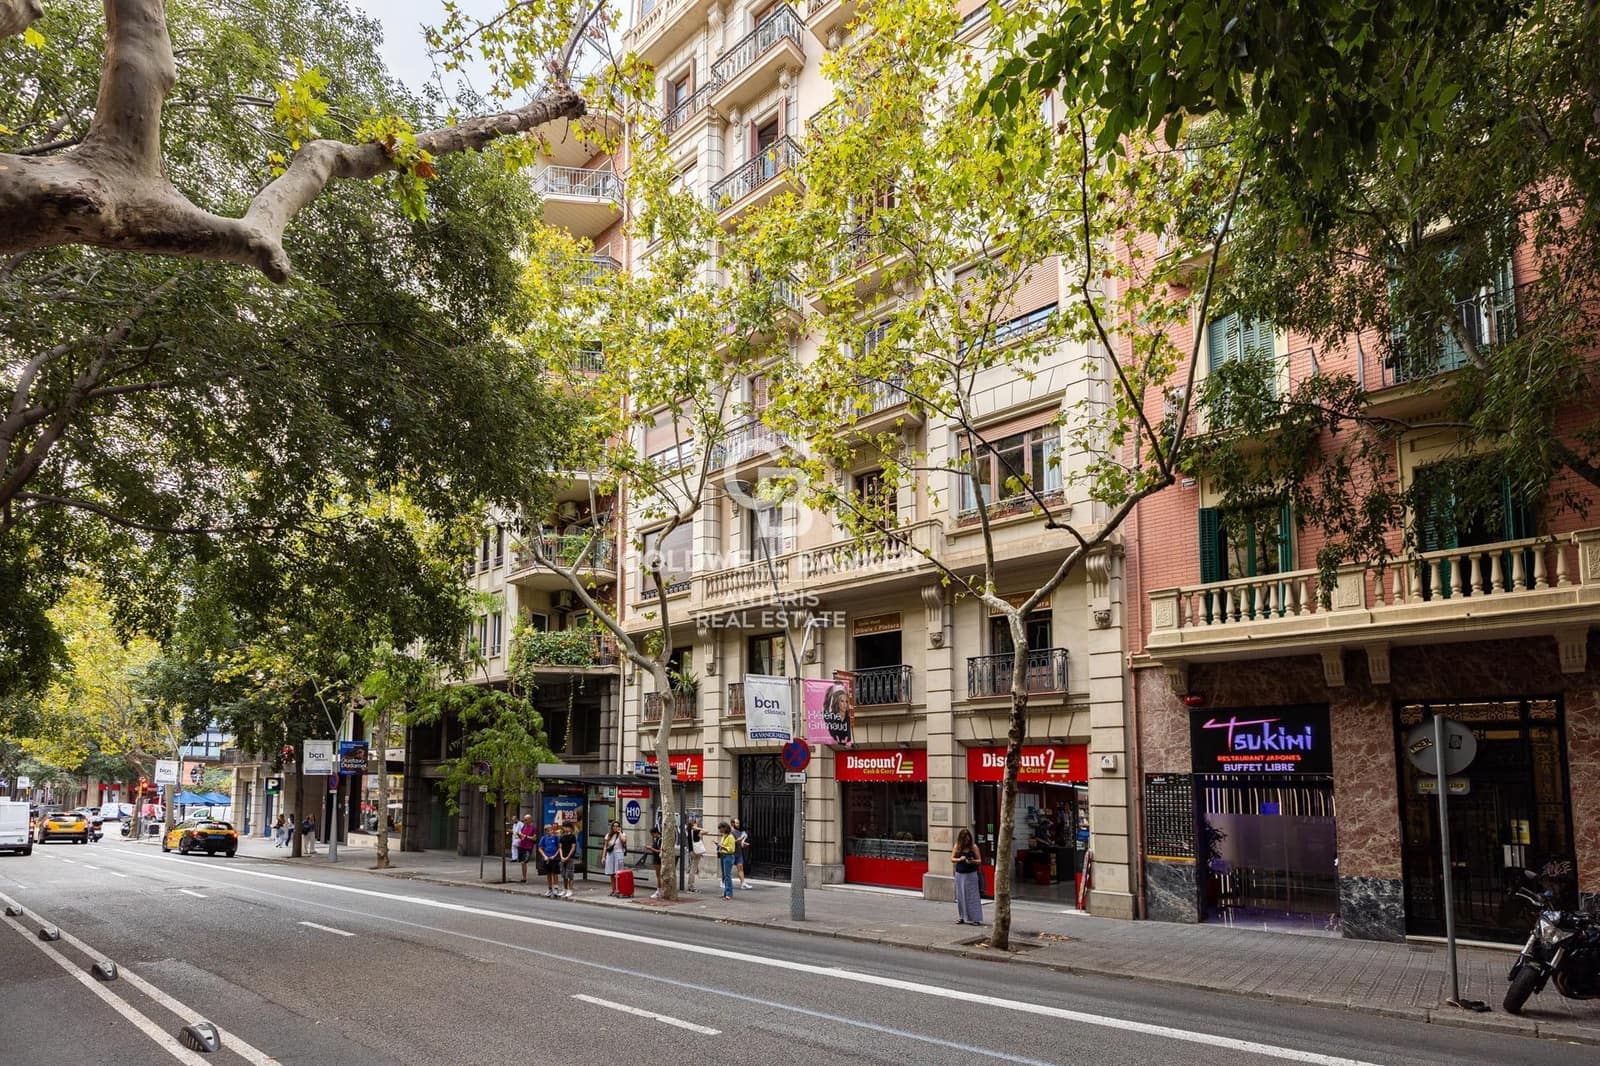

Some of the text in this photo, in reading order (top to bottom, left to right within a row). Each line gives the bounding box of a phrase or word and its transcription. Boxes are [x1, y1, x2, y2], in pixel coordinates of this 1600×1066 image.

[754, 696, 780, 709] bcn
[1223, 763, 1295, 772] BUFFET LIBRE
[267, 779, 279, 790] P
[626, 807, 640, 817] H10
